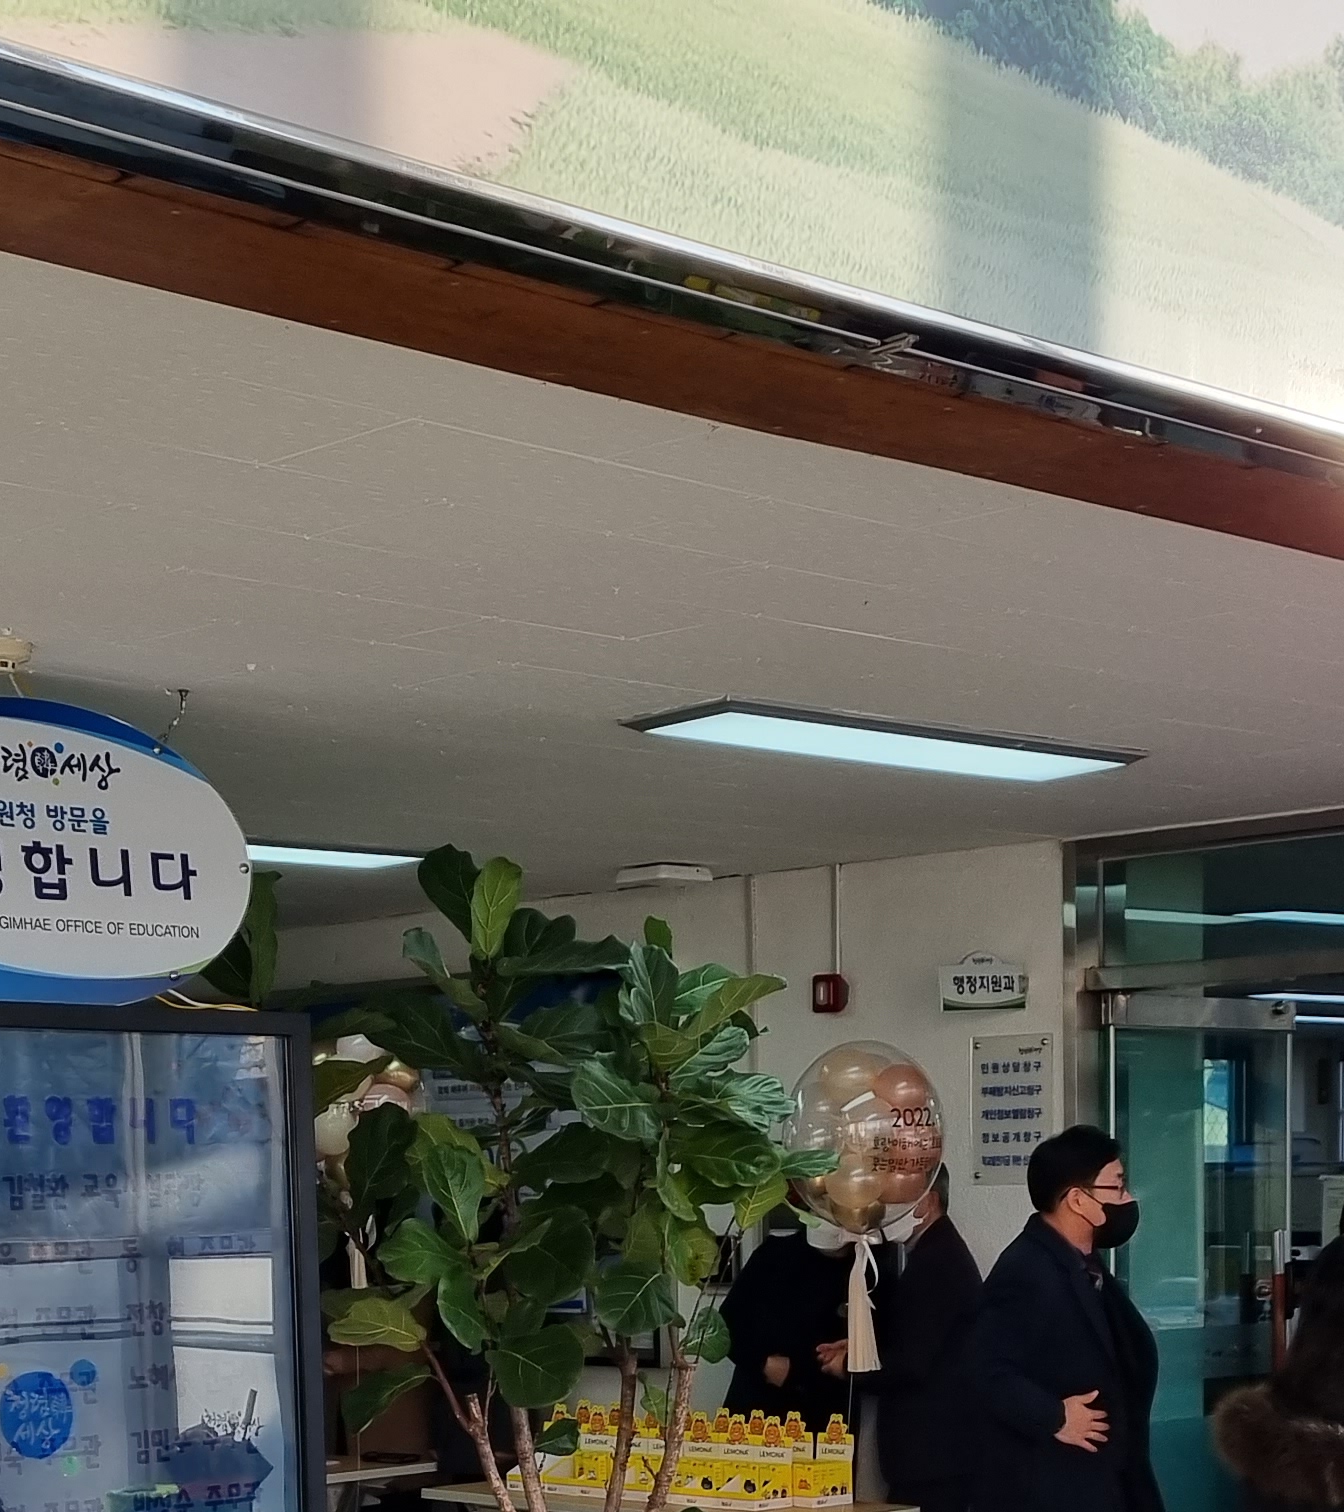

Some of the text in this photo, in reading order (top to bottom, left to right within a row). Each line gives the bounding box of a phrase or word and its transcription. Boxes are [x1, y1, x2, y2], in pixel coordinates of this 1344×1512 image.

[45, 803, 110, 836] 방문을
[0, 916, 52, 931] GIMHAE
[56, 919, 103, 934] OFFICE
[107, 921, 124, 935] OF
[129, 922, 200, 939] EDUCATION
